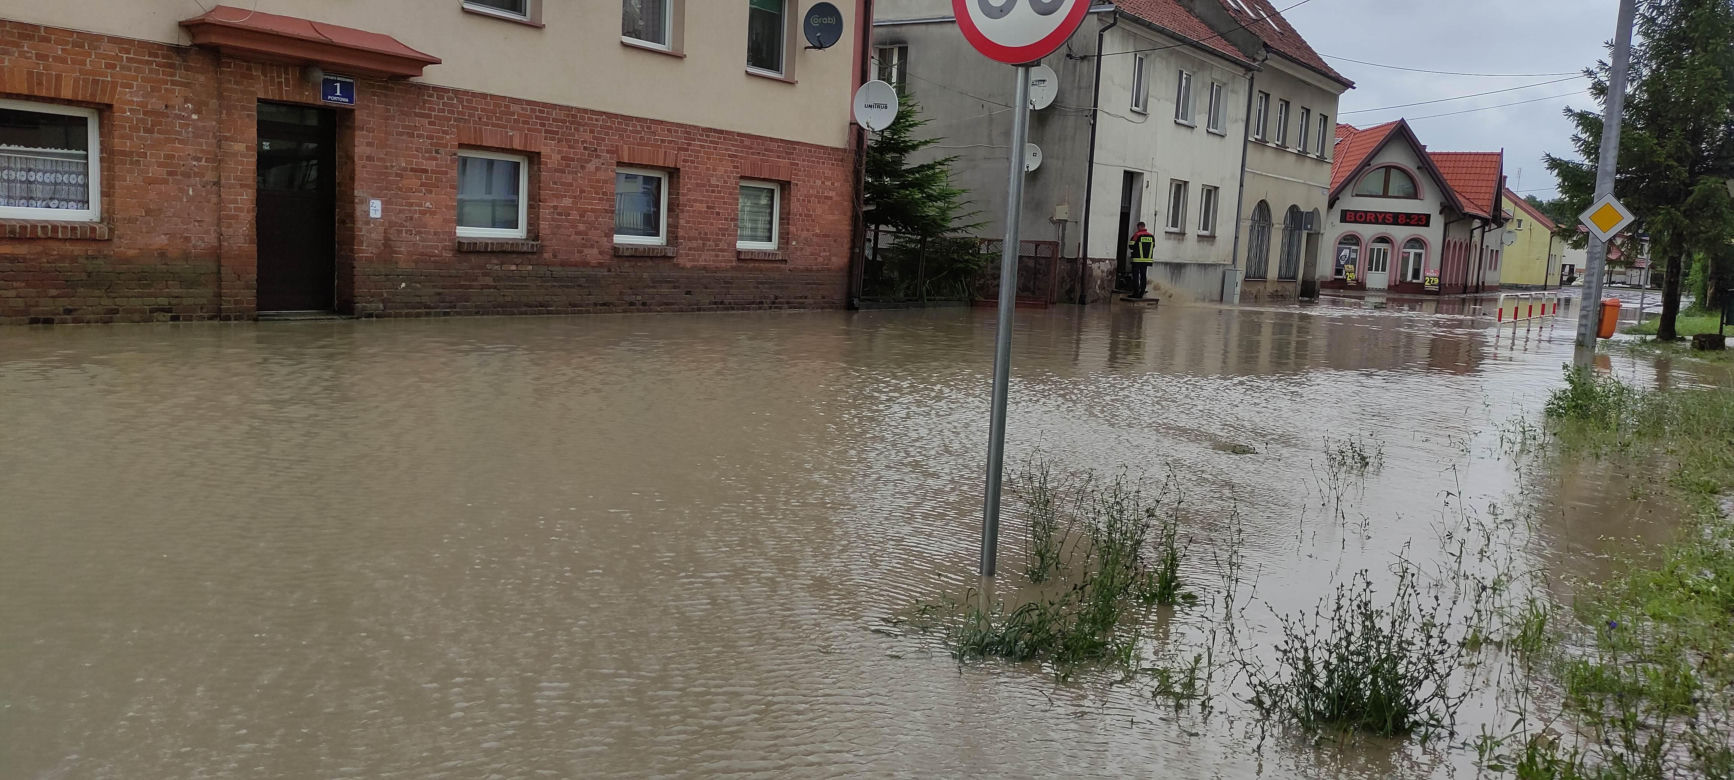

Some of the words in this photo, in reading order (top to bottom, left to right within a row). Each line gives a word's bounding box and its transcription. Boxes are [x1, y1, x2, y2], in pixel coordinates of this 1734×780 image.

[333, 82, 342, 96] 1
[1345, 211, 1393, 224] BORYS
[1397, 214, 1426, 225] 8-23
